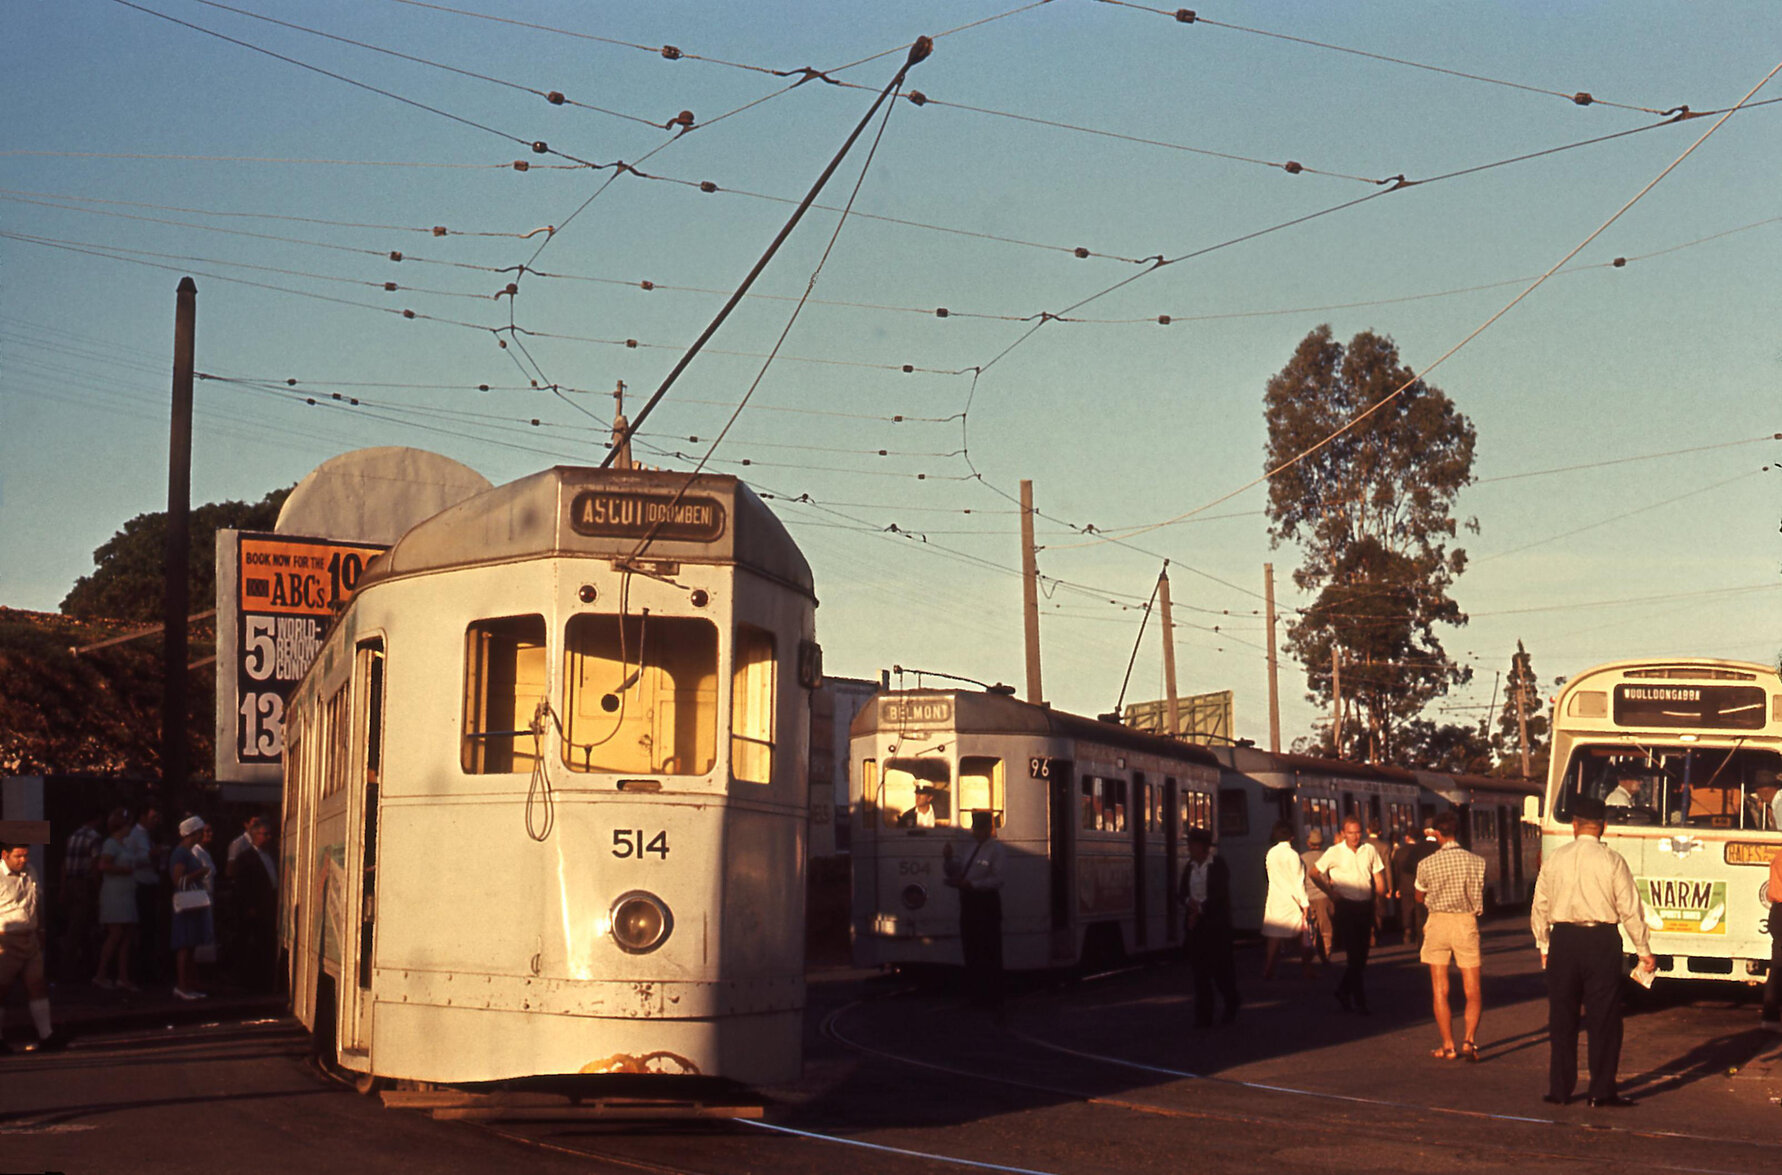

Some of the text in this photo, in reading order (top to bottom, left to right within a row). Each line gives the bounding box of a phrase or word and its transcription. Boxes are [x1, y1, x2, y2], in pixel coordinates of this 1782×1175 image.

[246, 552, 325, 570] BOOK NOW FOR THE
[270, 572, 325, 608] ABC's
[245, 615, 275, 680] 5
[1624, 688, 1701, 700] WOOLLOONGABBA
[240, 692, 284, 757] 13
[1031, 759, 1049, 777] 96
[611, 829, 670, 860] 514
[899, 861, 931, 876] 504
[1649, 880, 1712, 909] NARM
